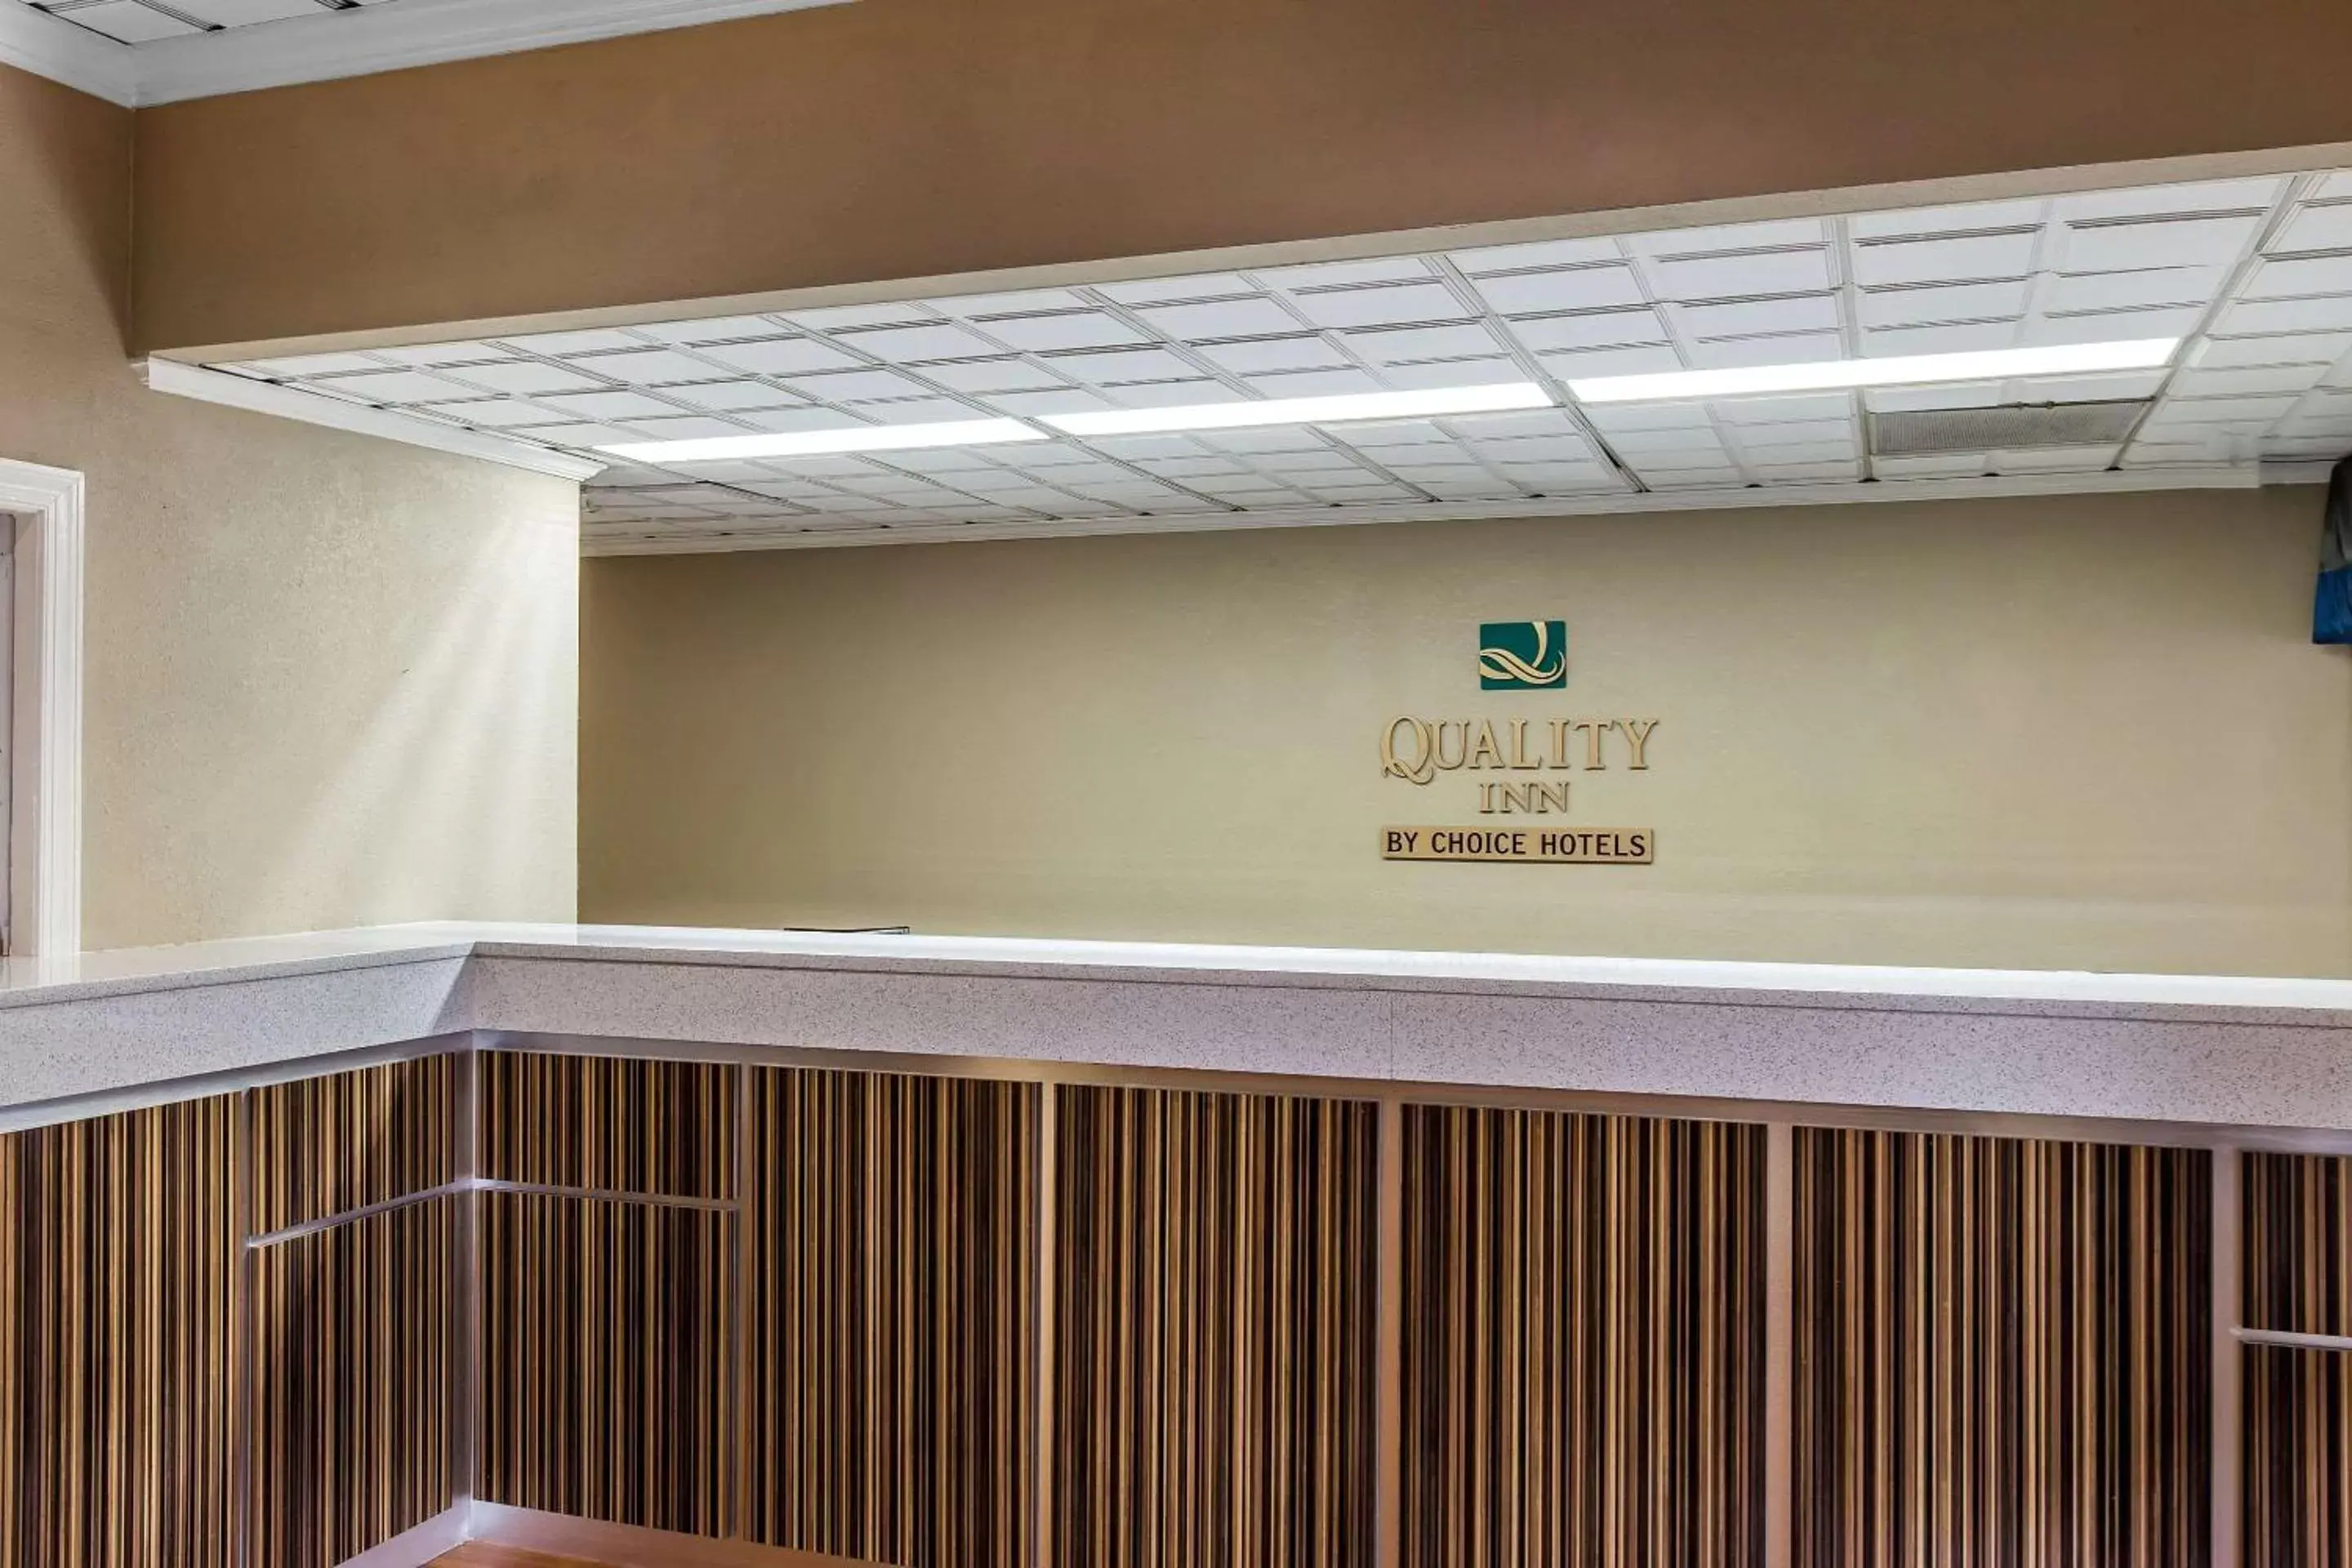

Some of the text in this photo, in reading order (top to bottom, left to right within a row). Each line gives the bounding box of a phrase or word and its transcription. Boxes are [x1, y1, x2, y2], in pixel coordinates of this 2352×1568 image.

[1380, 715, 1659, 785] QUALITY
[1479, 782, 1570, 814] INN
[1387, 831, 1646, 857] BY CHOICE HOTELS
